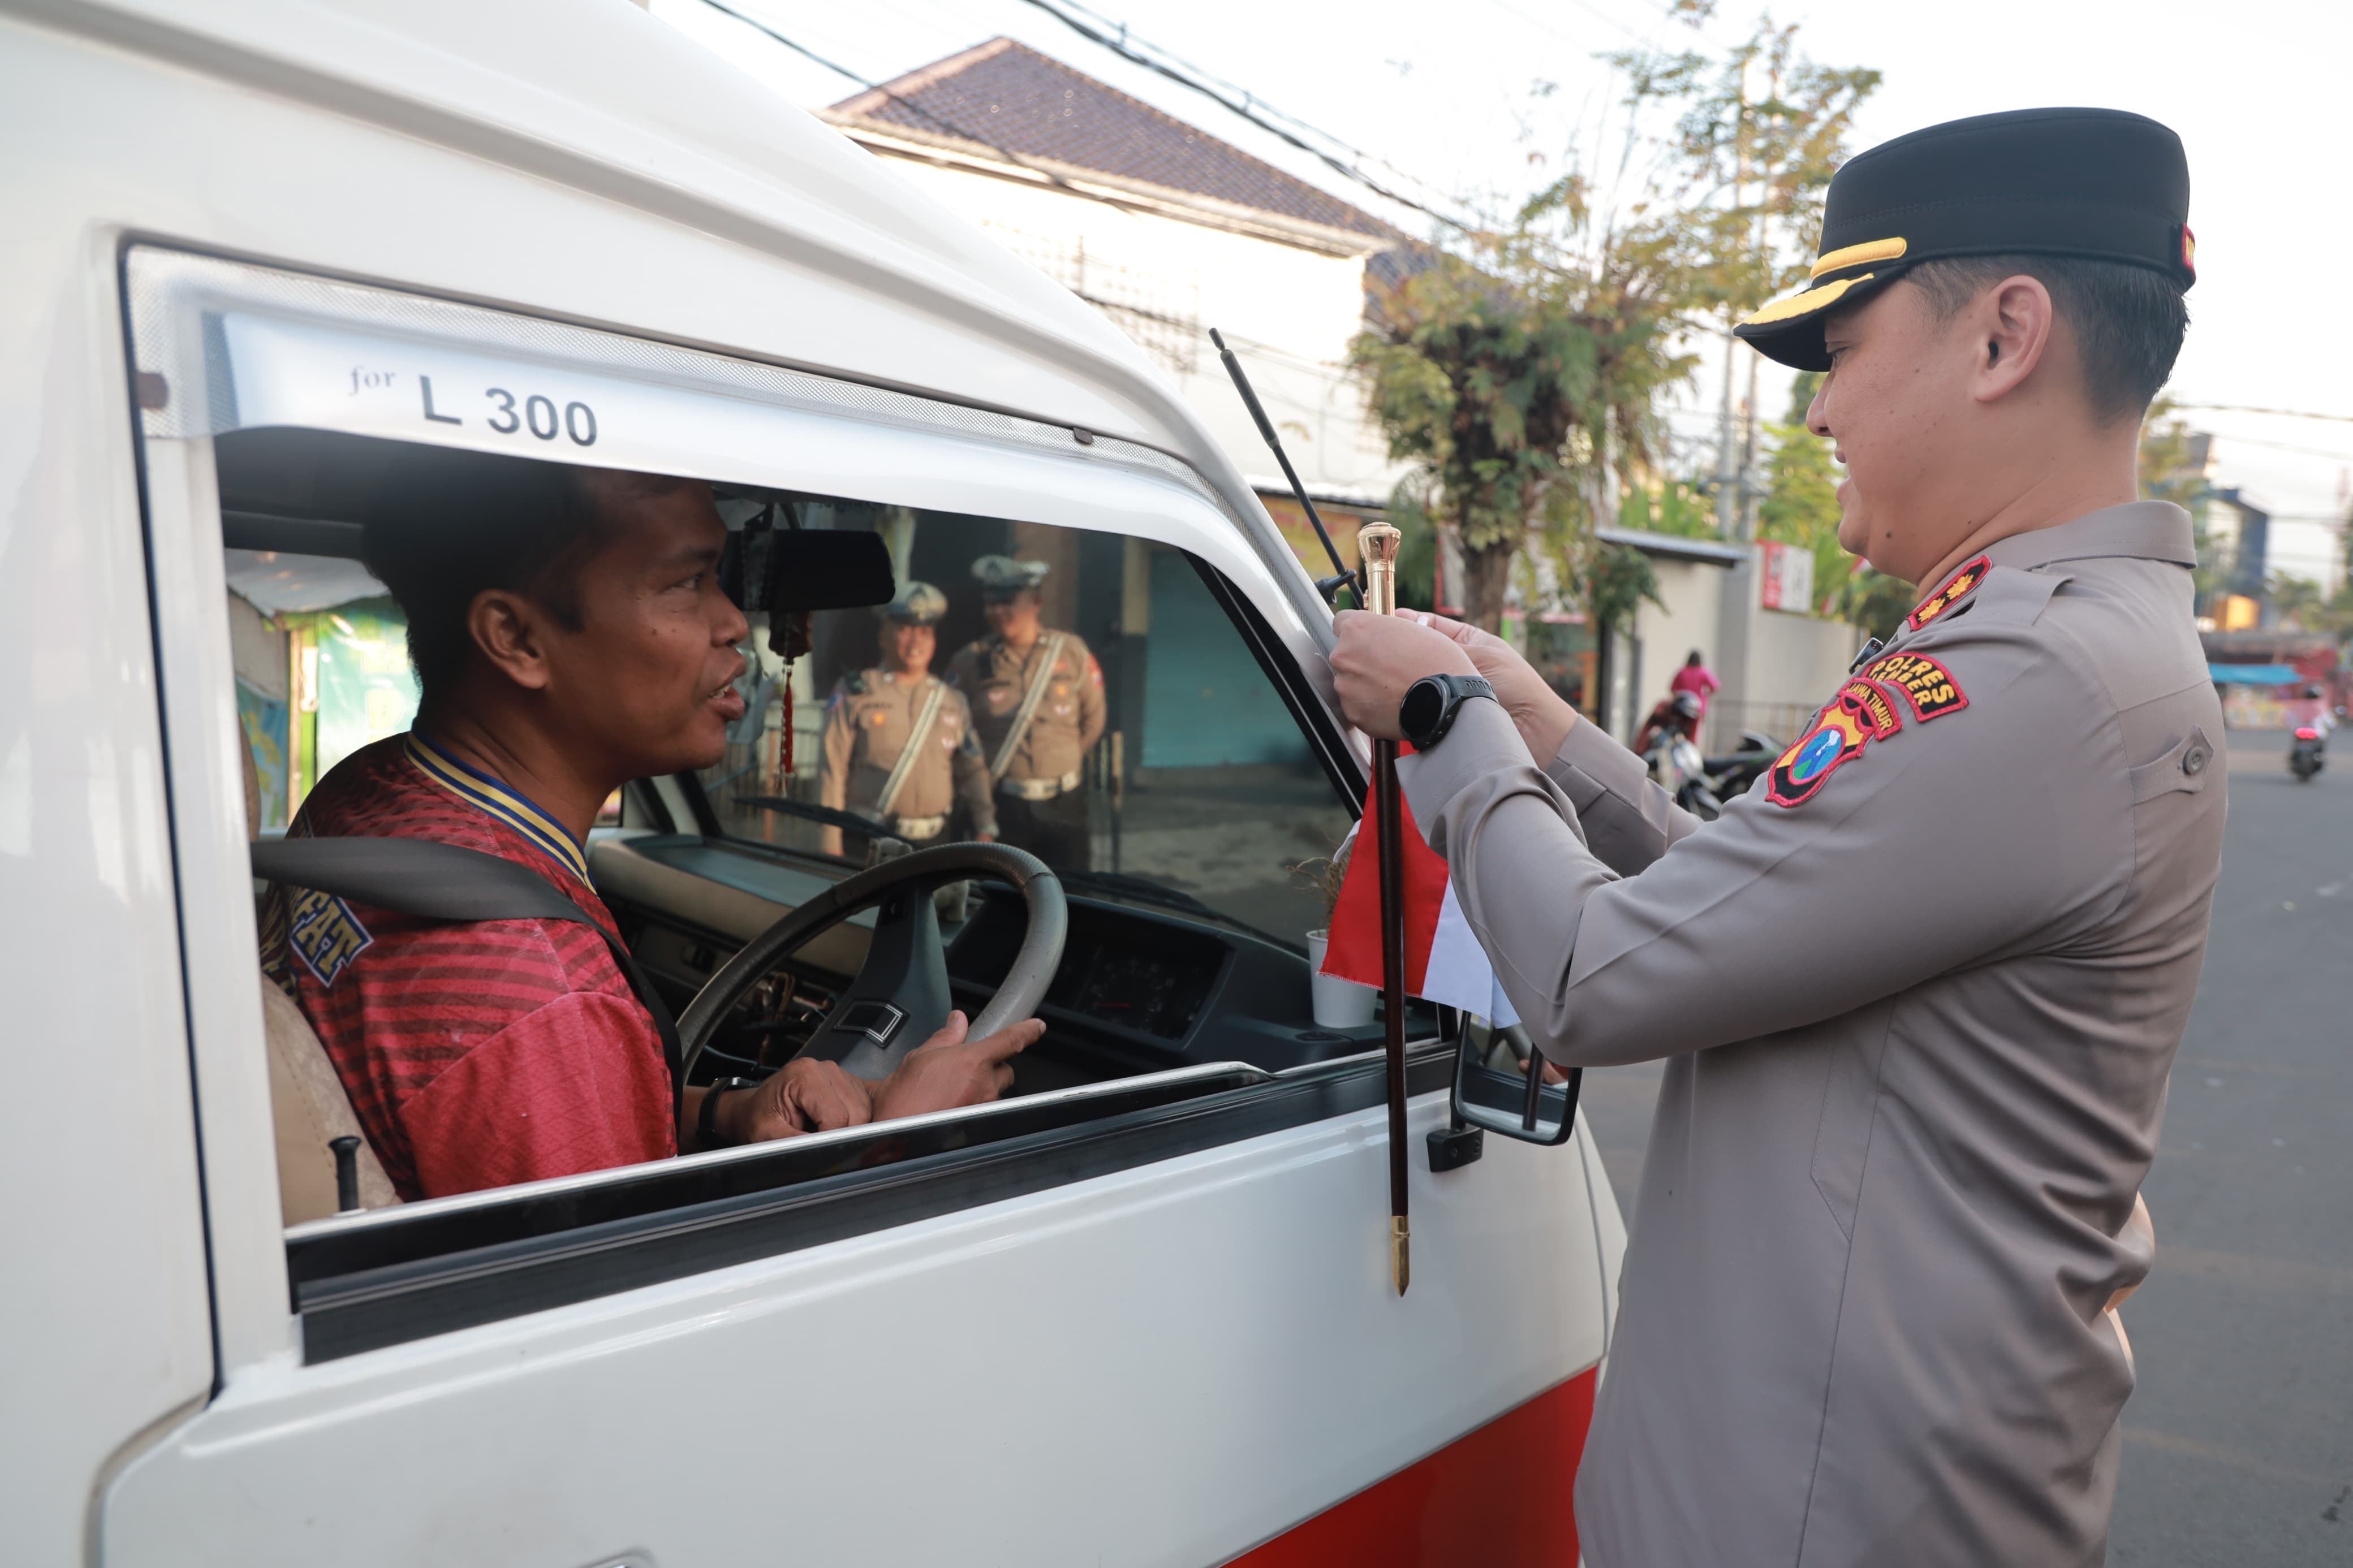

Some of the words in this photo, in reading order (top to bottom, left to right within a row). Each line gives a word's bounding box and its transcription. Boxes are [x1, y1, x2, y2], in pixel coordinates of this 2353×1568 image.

[348, 365, 397, 397] for
[419, 374, 463, 426] L
[485, 387, 598, 447] 300
[1868, 655, 1955, 704] POLRES
[1846, 683, 1872, 700] JAWA
[1868, 693, 1894, 732] TIMUR
